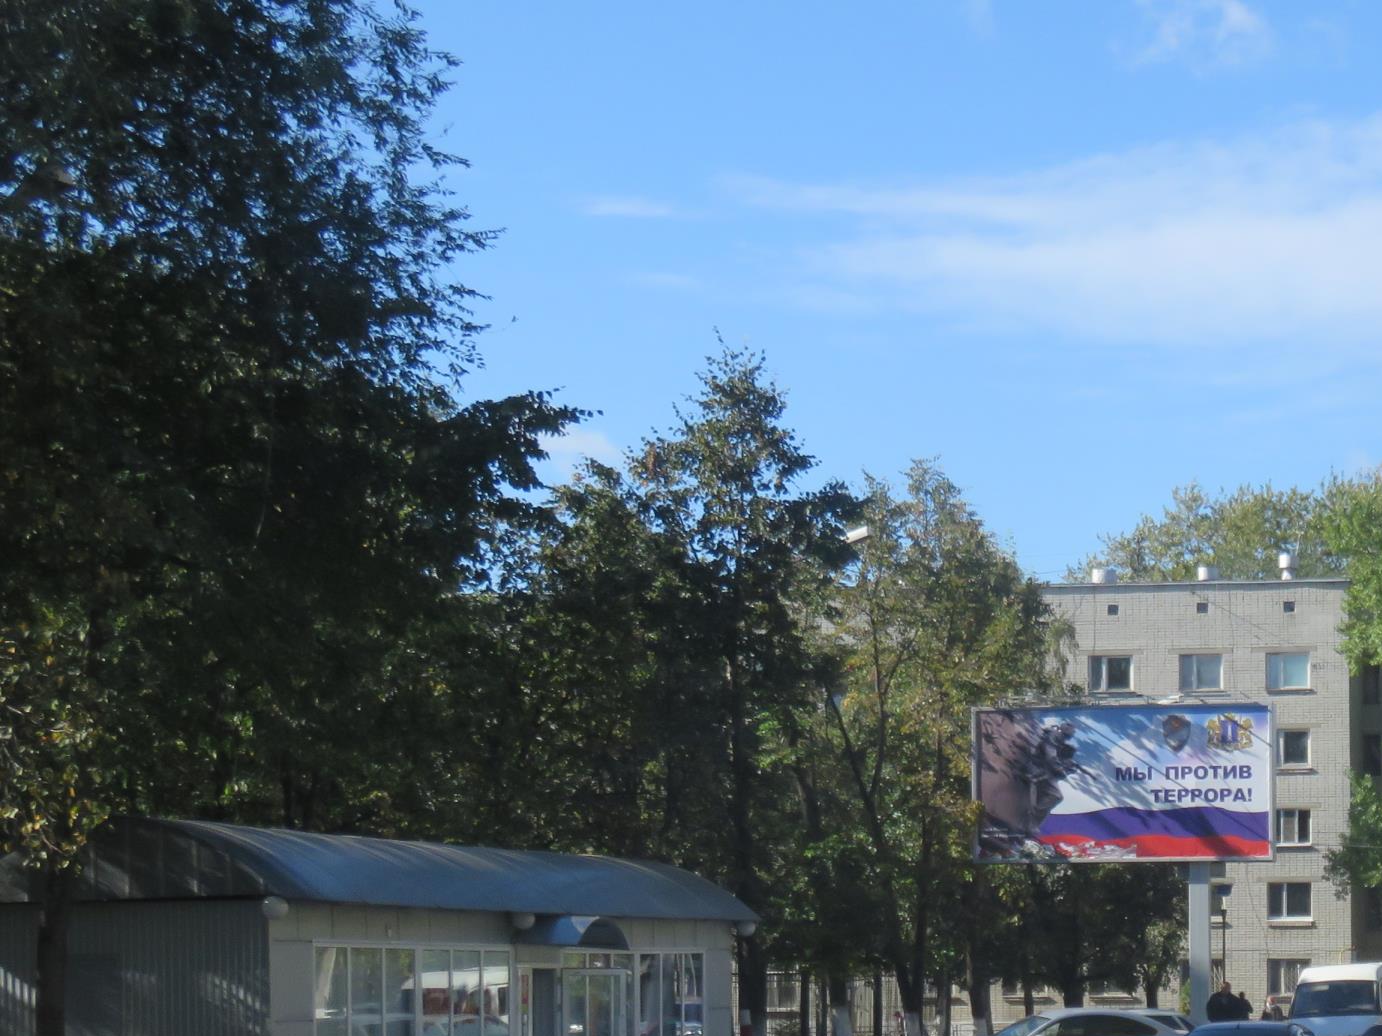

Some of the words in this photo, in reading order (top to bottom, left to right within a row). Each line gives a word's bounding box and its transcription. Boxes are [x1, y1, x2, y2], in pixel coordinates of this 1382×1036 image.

[1115, 766, 1152, 781] МЫ
[1165, 765, 1252, 780] ПРОТИВ
[1151, 788, 1252, 803] ТЕРРОРА!
